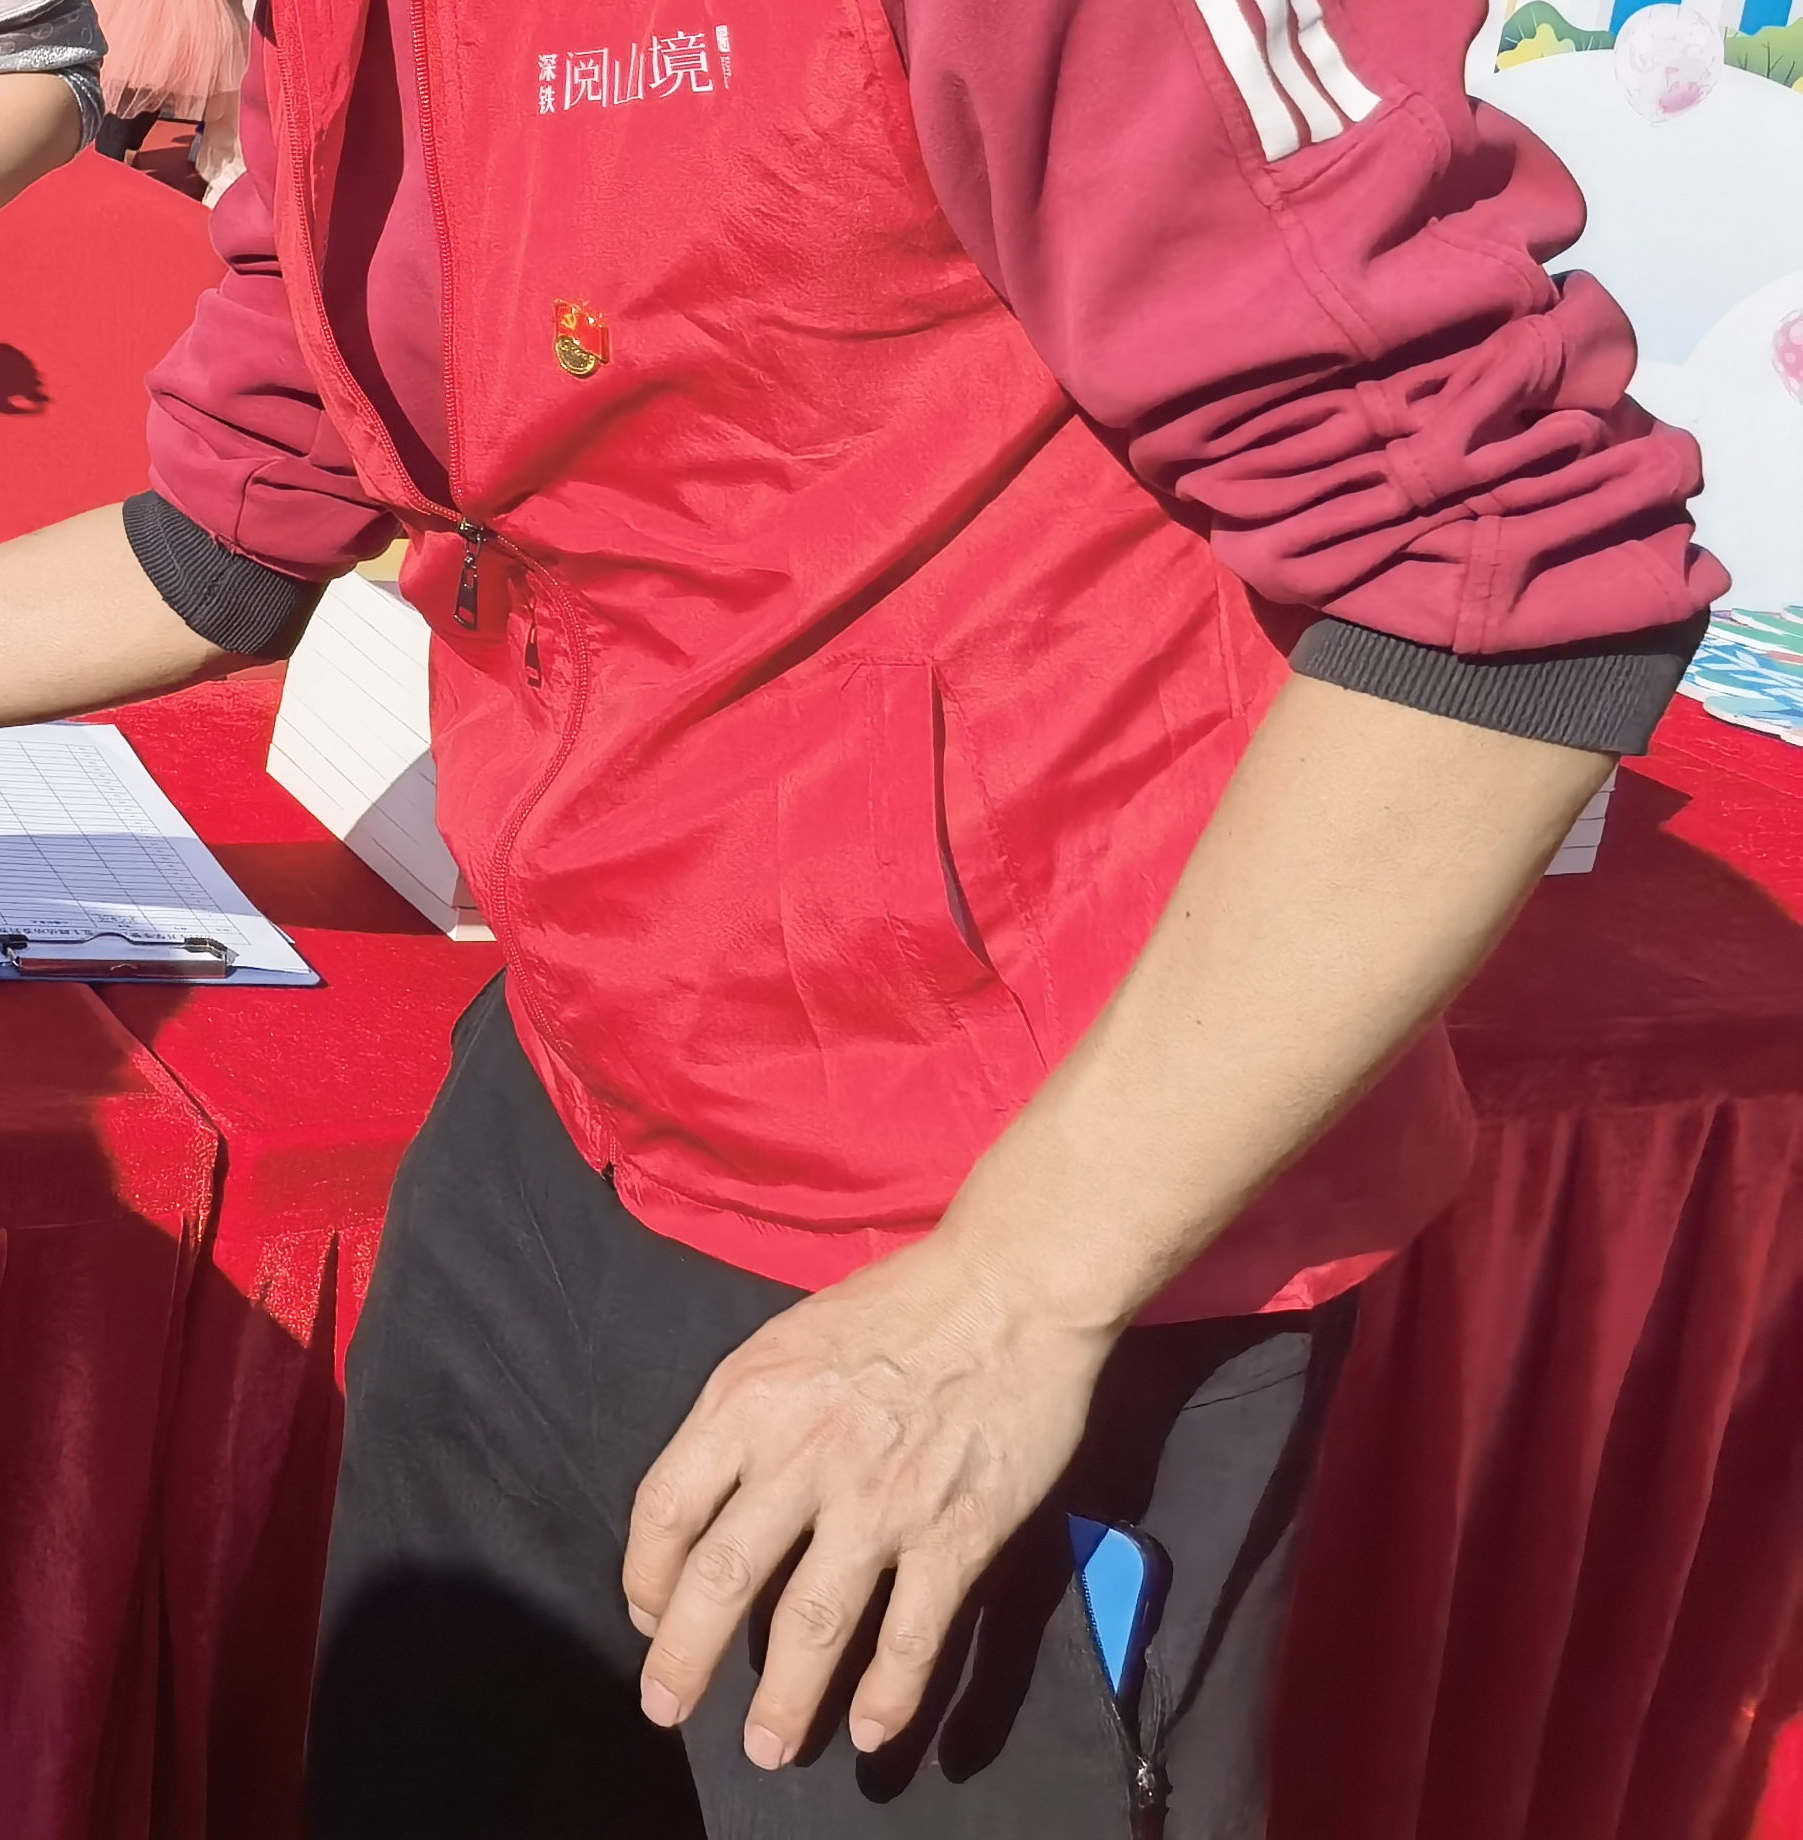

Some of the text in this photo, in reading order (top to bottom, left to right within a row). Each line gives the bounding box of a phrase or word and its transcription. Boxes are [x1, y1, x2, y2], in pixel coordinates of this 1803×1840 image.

[537, 52, 559, 115] 深铁
[563, 29, 715, 111] 阅山境
